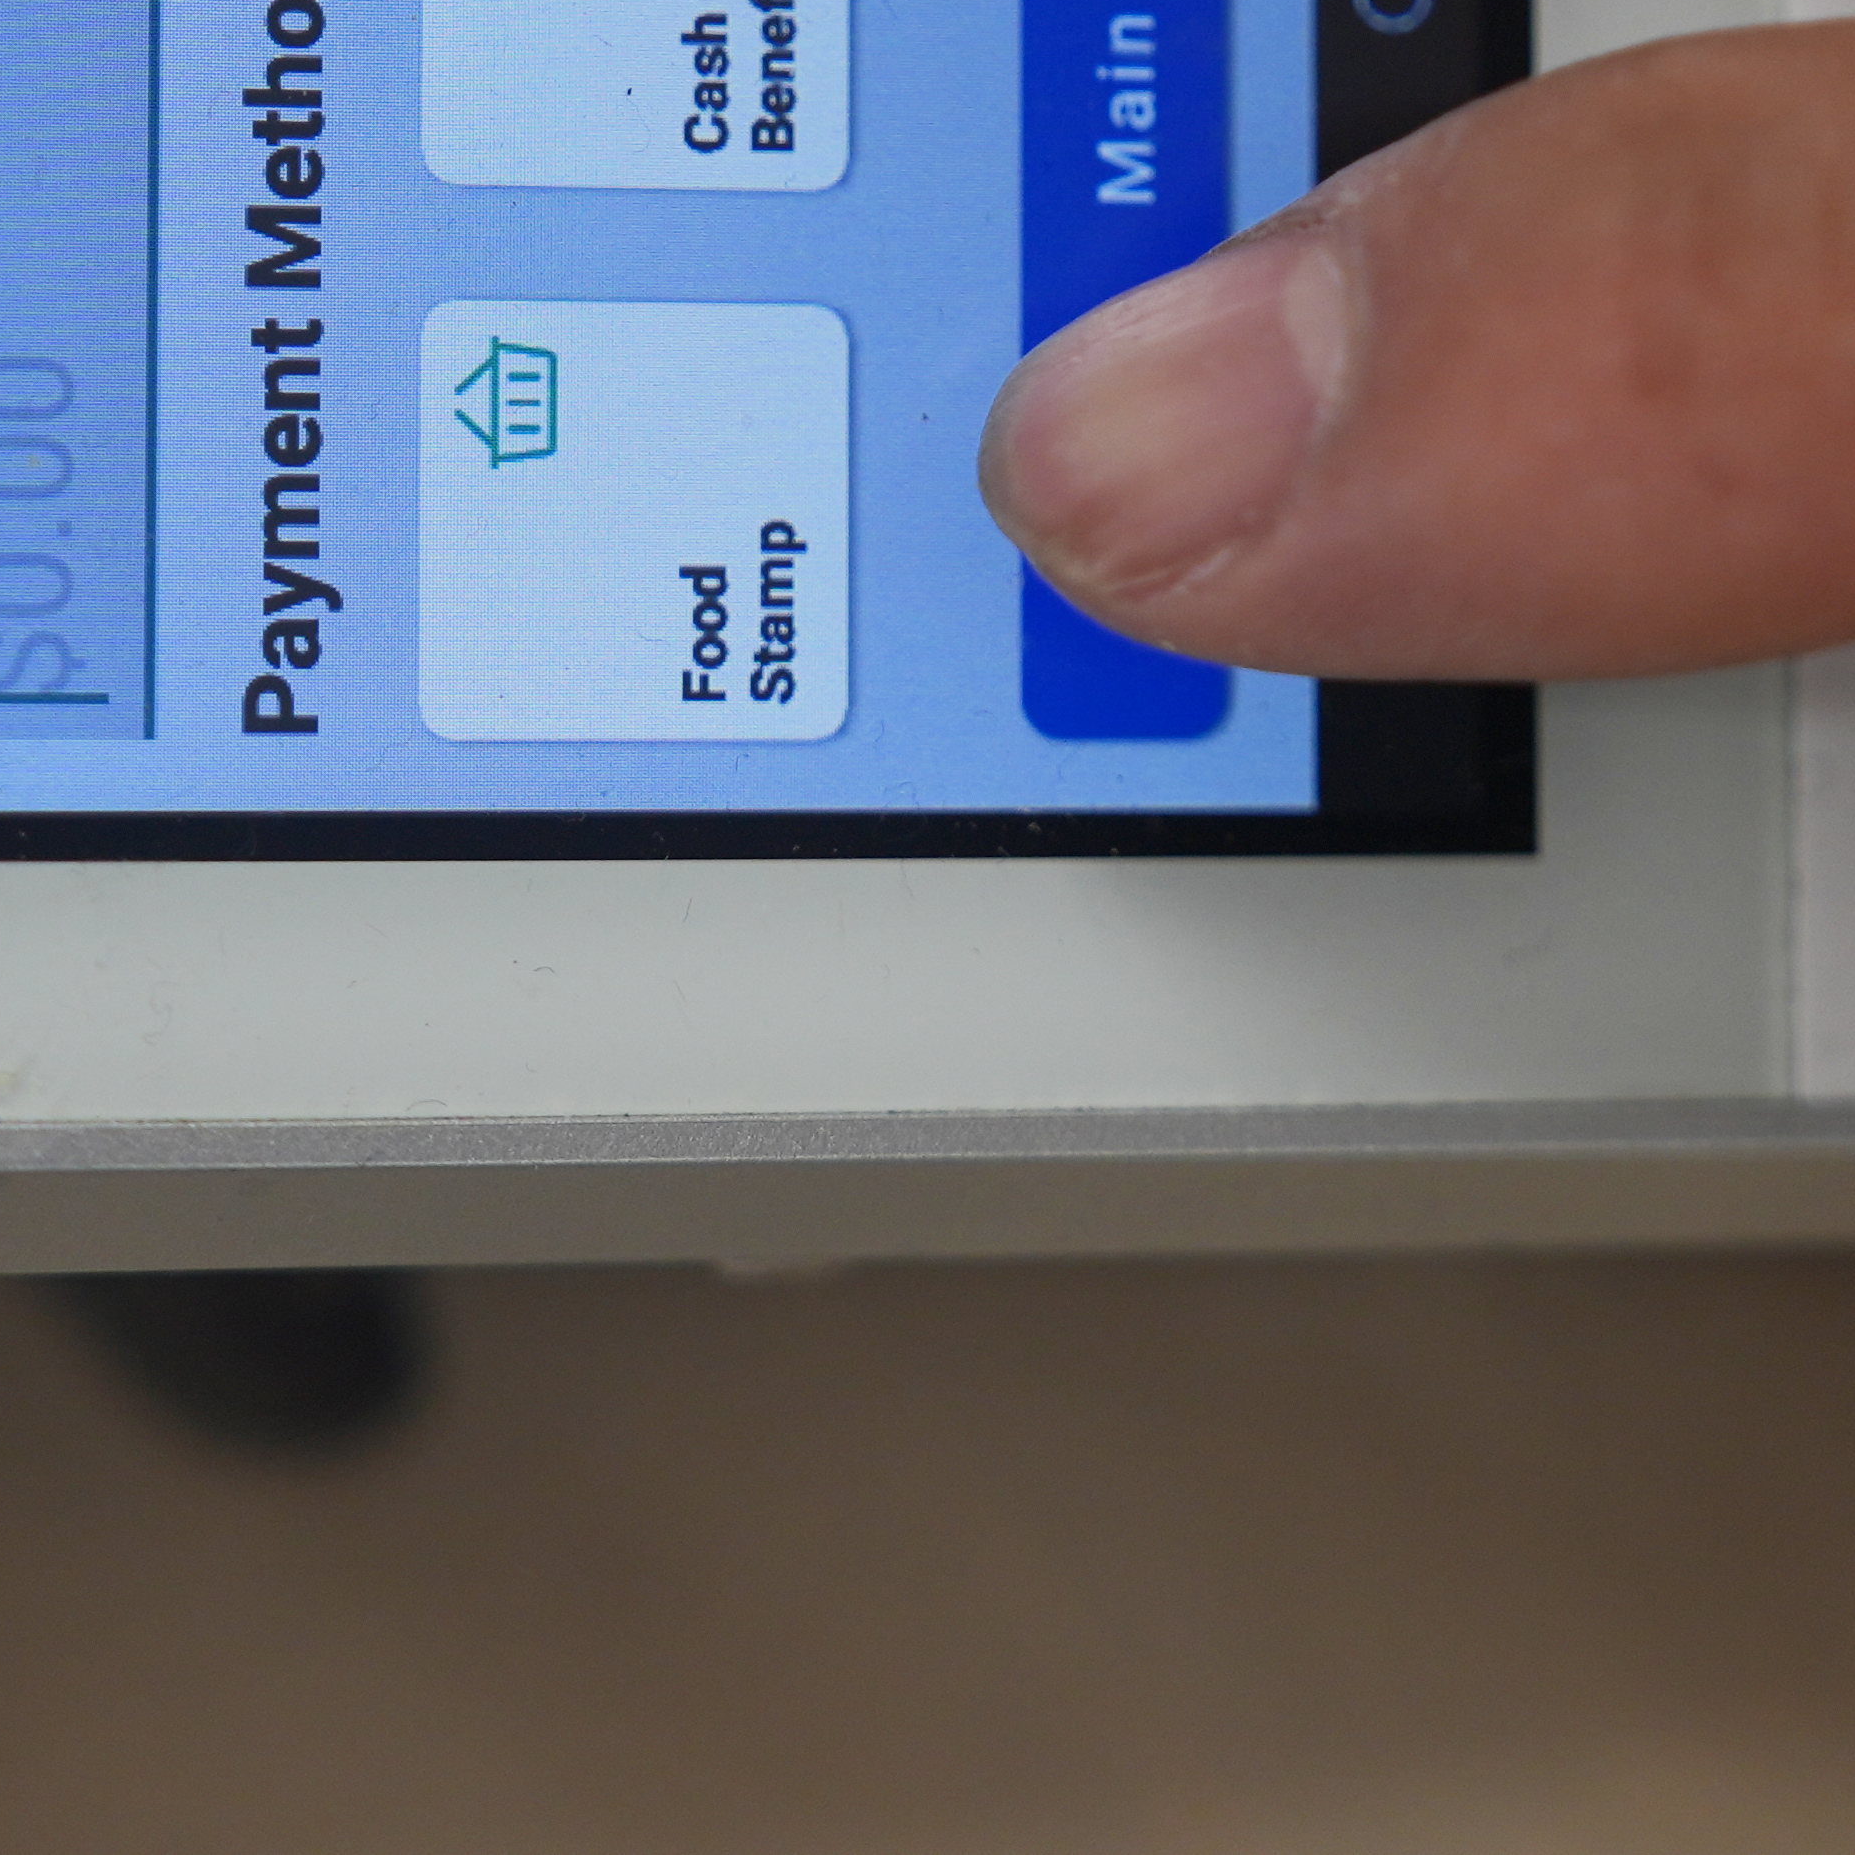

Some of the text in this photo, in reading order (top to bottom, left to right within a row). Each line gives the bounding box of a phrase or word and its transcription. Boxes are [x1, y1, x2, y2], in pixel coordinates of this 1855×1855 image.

[682, 11, 730, 155] Cash
[1097, 10, 1158, 206] Main
[240, 316, 344, 735] Payment
[749, 518, 807, 706] Stamp
[681, 562, 729, 704] Food
